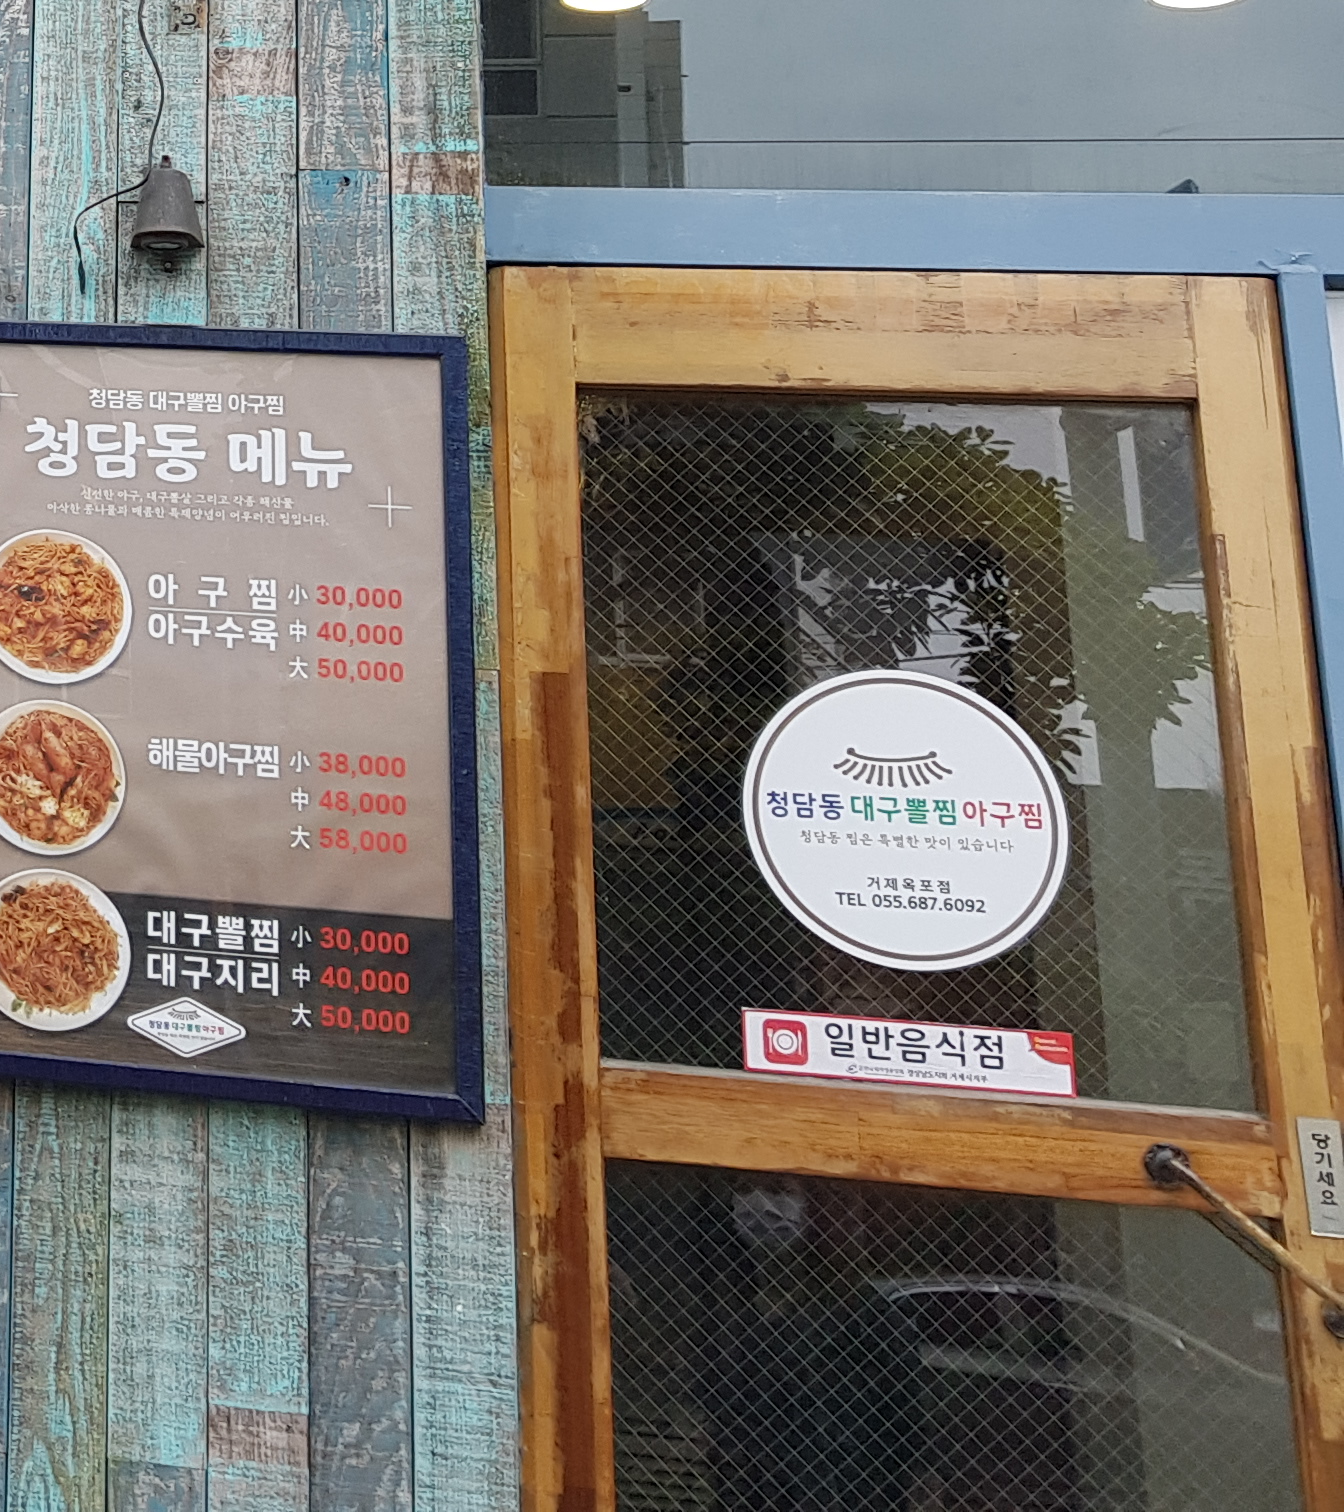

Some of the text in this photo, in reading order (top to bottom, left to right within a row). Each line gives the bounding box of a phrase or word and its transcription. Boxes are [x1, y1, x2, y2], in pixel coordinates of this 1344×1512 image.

[88, 388, 284, 416] 청담동 대구뽈찜 아구찜
[24, 416, 353, 489] 청담동 메뉴
[288, 583, 403, 611] 小 30,000
[148, 611, 279, 650] 아구수육
[288, 619, 404, 647] 中 40,000
[288, 656, 405, 683] 大 50,000
[147, 736, 281, 779] 해물아구찜
[289, 749, 407, 779] 小 38,000
[290, 787, 407, 817] 中 48,000
[766, 790, 1043, 830] 청담동 대구뽈찜 아구찜
[290, 826, 408, 855] 大 58,000
[800, 829, 841, 845] 청담동
[878, 833, 919, 850] 특별한
[924, 836, 952, 851] 맛이
[957, 837, 1014, 854] 있습니다
[866, 875, 952, 894] 거제옥포점
[835, 891, 987, 914] TEL 055.687.6092
[146, 909, 281, 953] 대구뽈찜
[290, 925, 410, 956] 小 30,000
[146, 951, 281, 996] 대구지리
[291, 964, 410, 995] 中 40,000
[291, 1002, 410, 1035] 大 50,000
[824, 1022, 1004, 1070] 일반음식점
[1311, 1133, 1339, 1206] 당기세요
